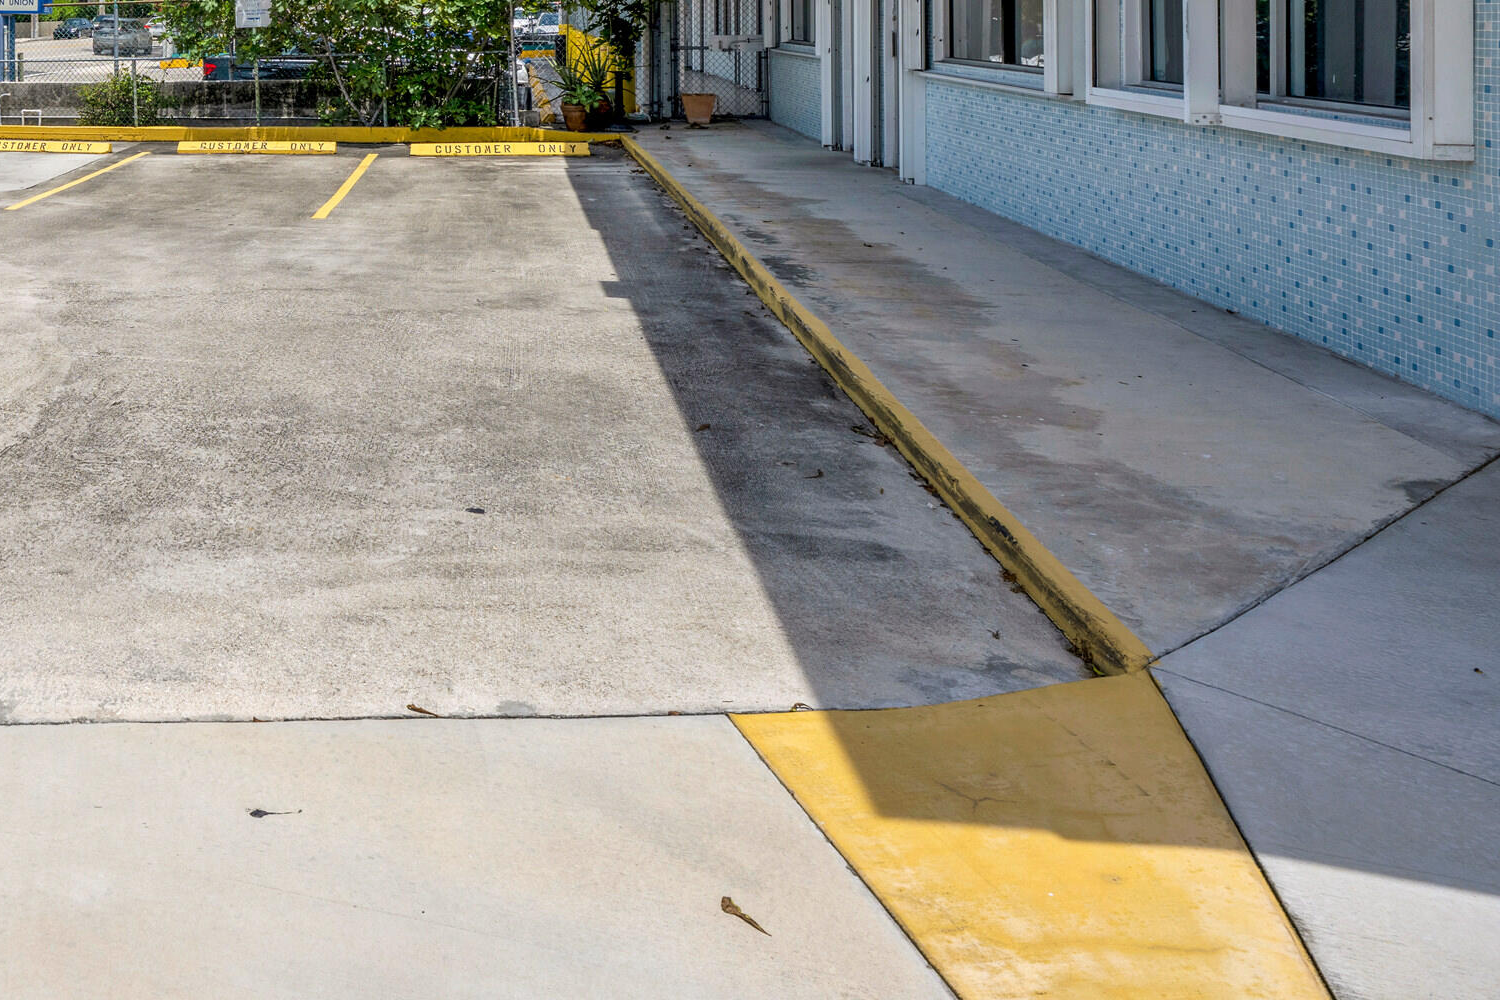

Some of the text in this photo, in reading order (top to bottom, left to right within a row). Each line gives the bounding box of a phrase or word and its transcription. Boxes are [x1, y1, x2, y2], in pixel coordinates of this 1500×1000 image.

[61, 142, 93, 151] ONLY
[200, 141, 325, 150] CUSTOMER ONLY
[435, 144, 577, 154] CUSTOMER ONLY
